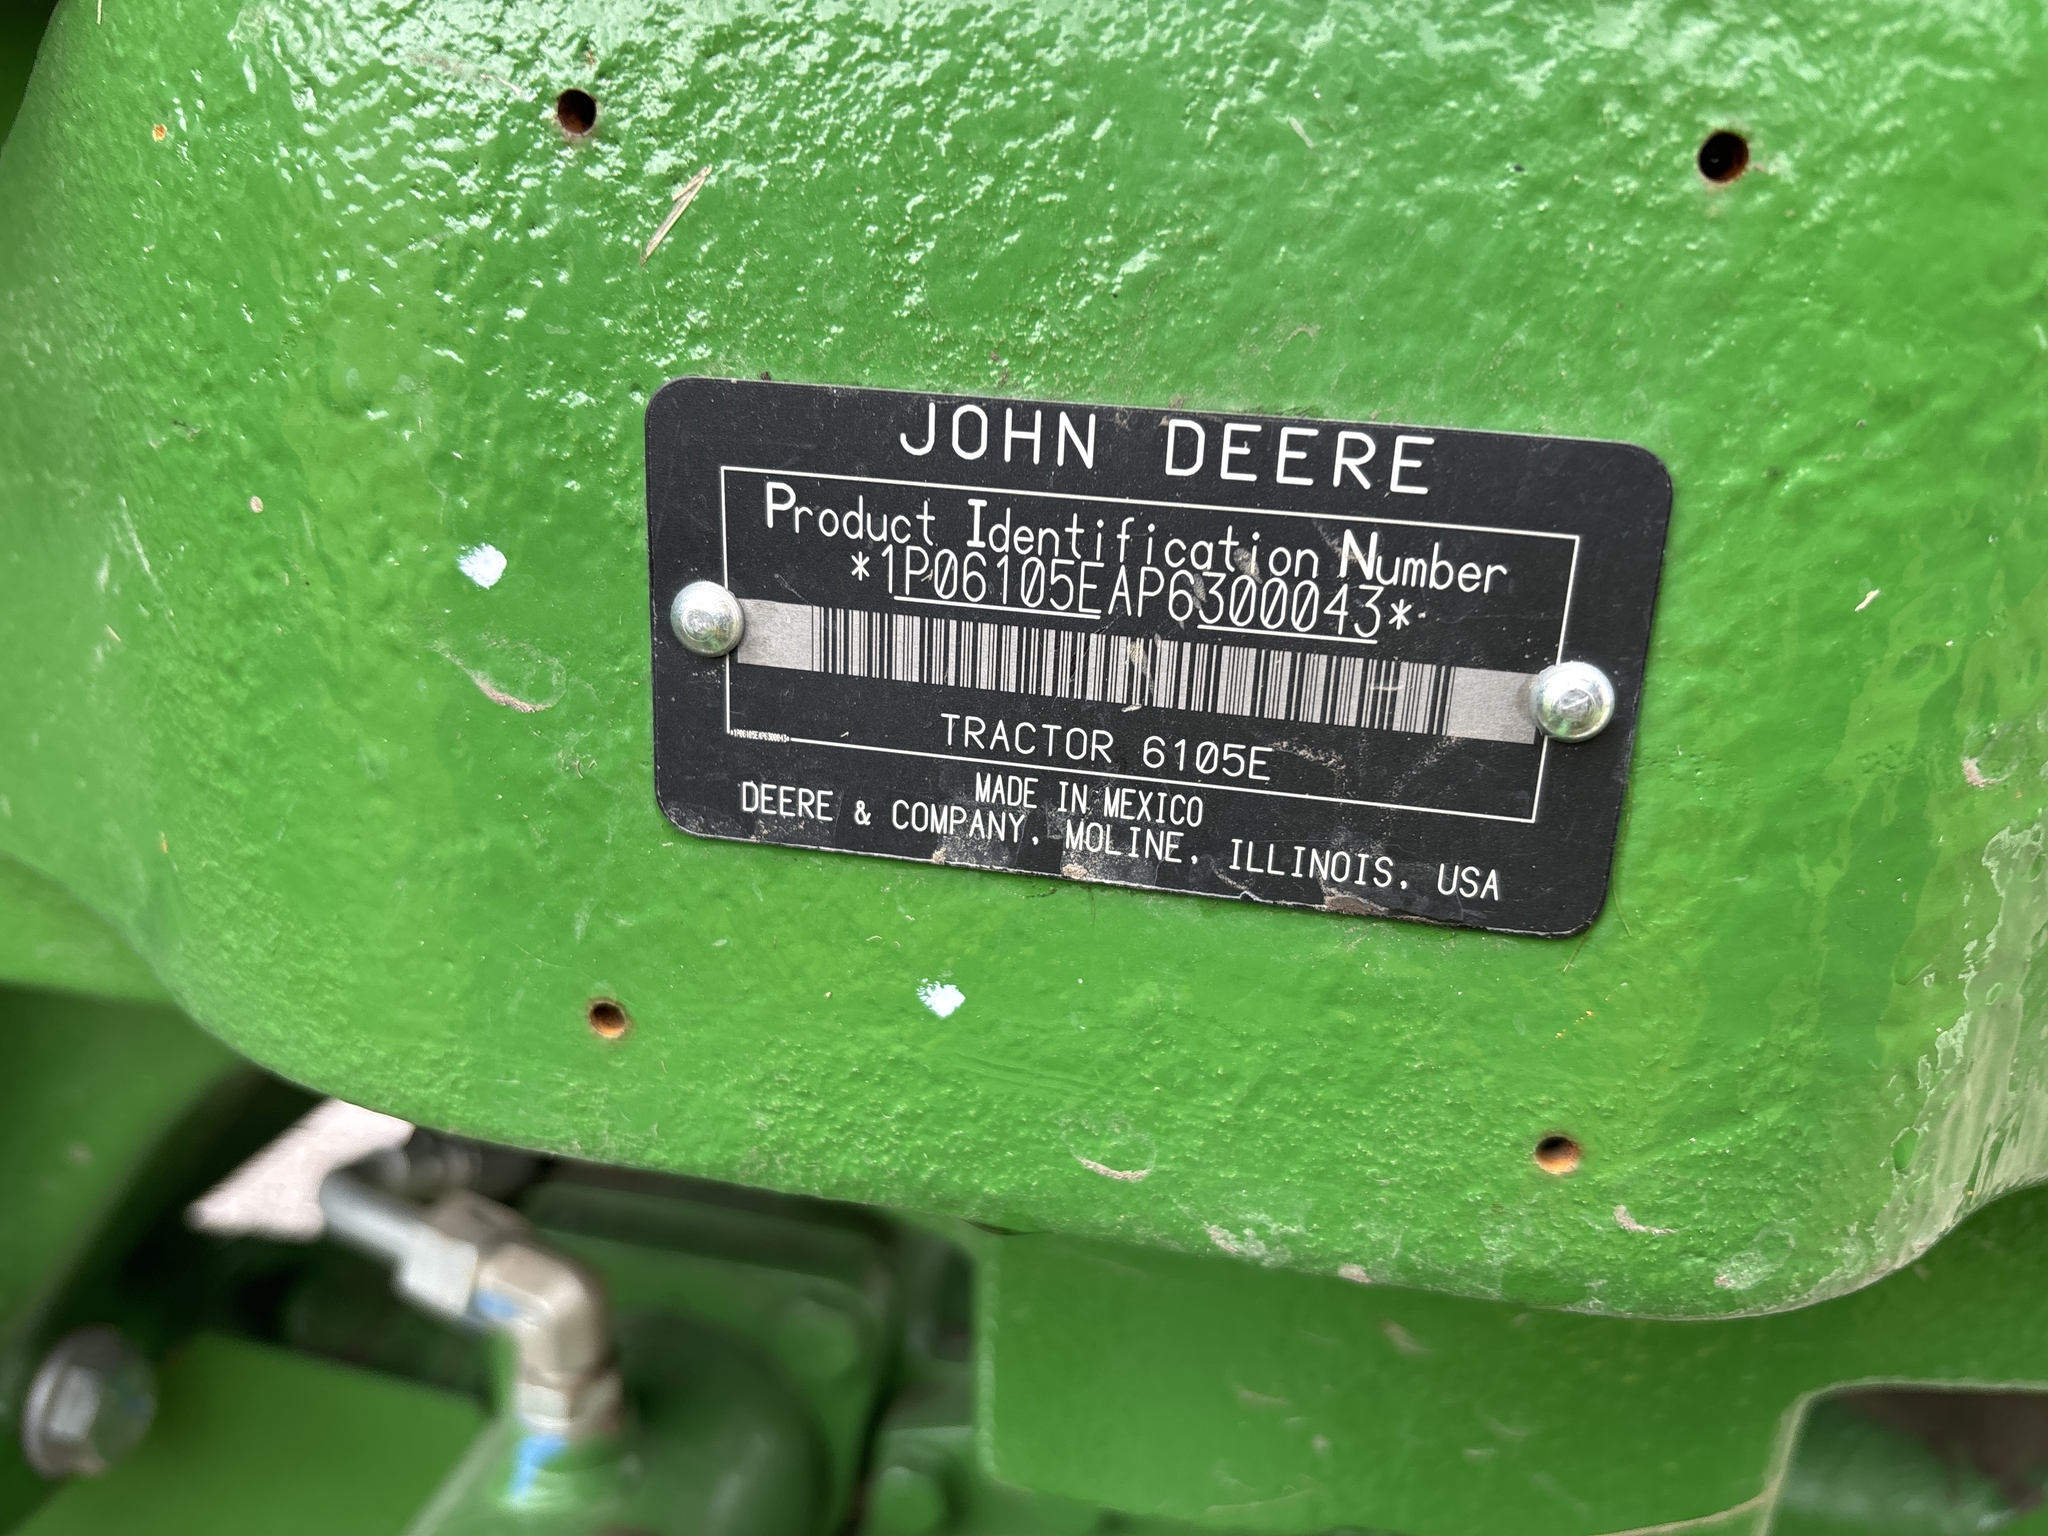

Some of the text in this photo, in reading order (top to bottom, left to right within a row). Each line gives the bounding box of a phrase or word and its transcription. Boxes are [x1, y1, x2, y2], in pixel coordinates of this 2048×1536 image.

[900, 402, 1435, 495] JOHN DEERE
[766, 481, 1508, 593] Product Identification Number
[940, 712, 1274, 782] TRACTOR 6105E
[741, 780, 834, 822] DEERE
[853, 800, 872, 826] &
[891, 799, 1040, 846] COMPANY,
[1065, 818, 1199, 866] MOLINE,
[1436, 862, 1500, 902] USA
[975, 771, 1204, 828] MADE IN MEXICO
